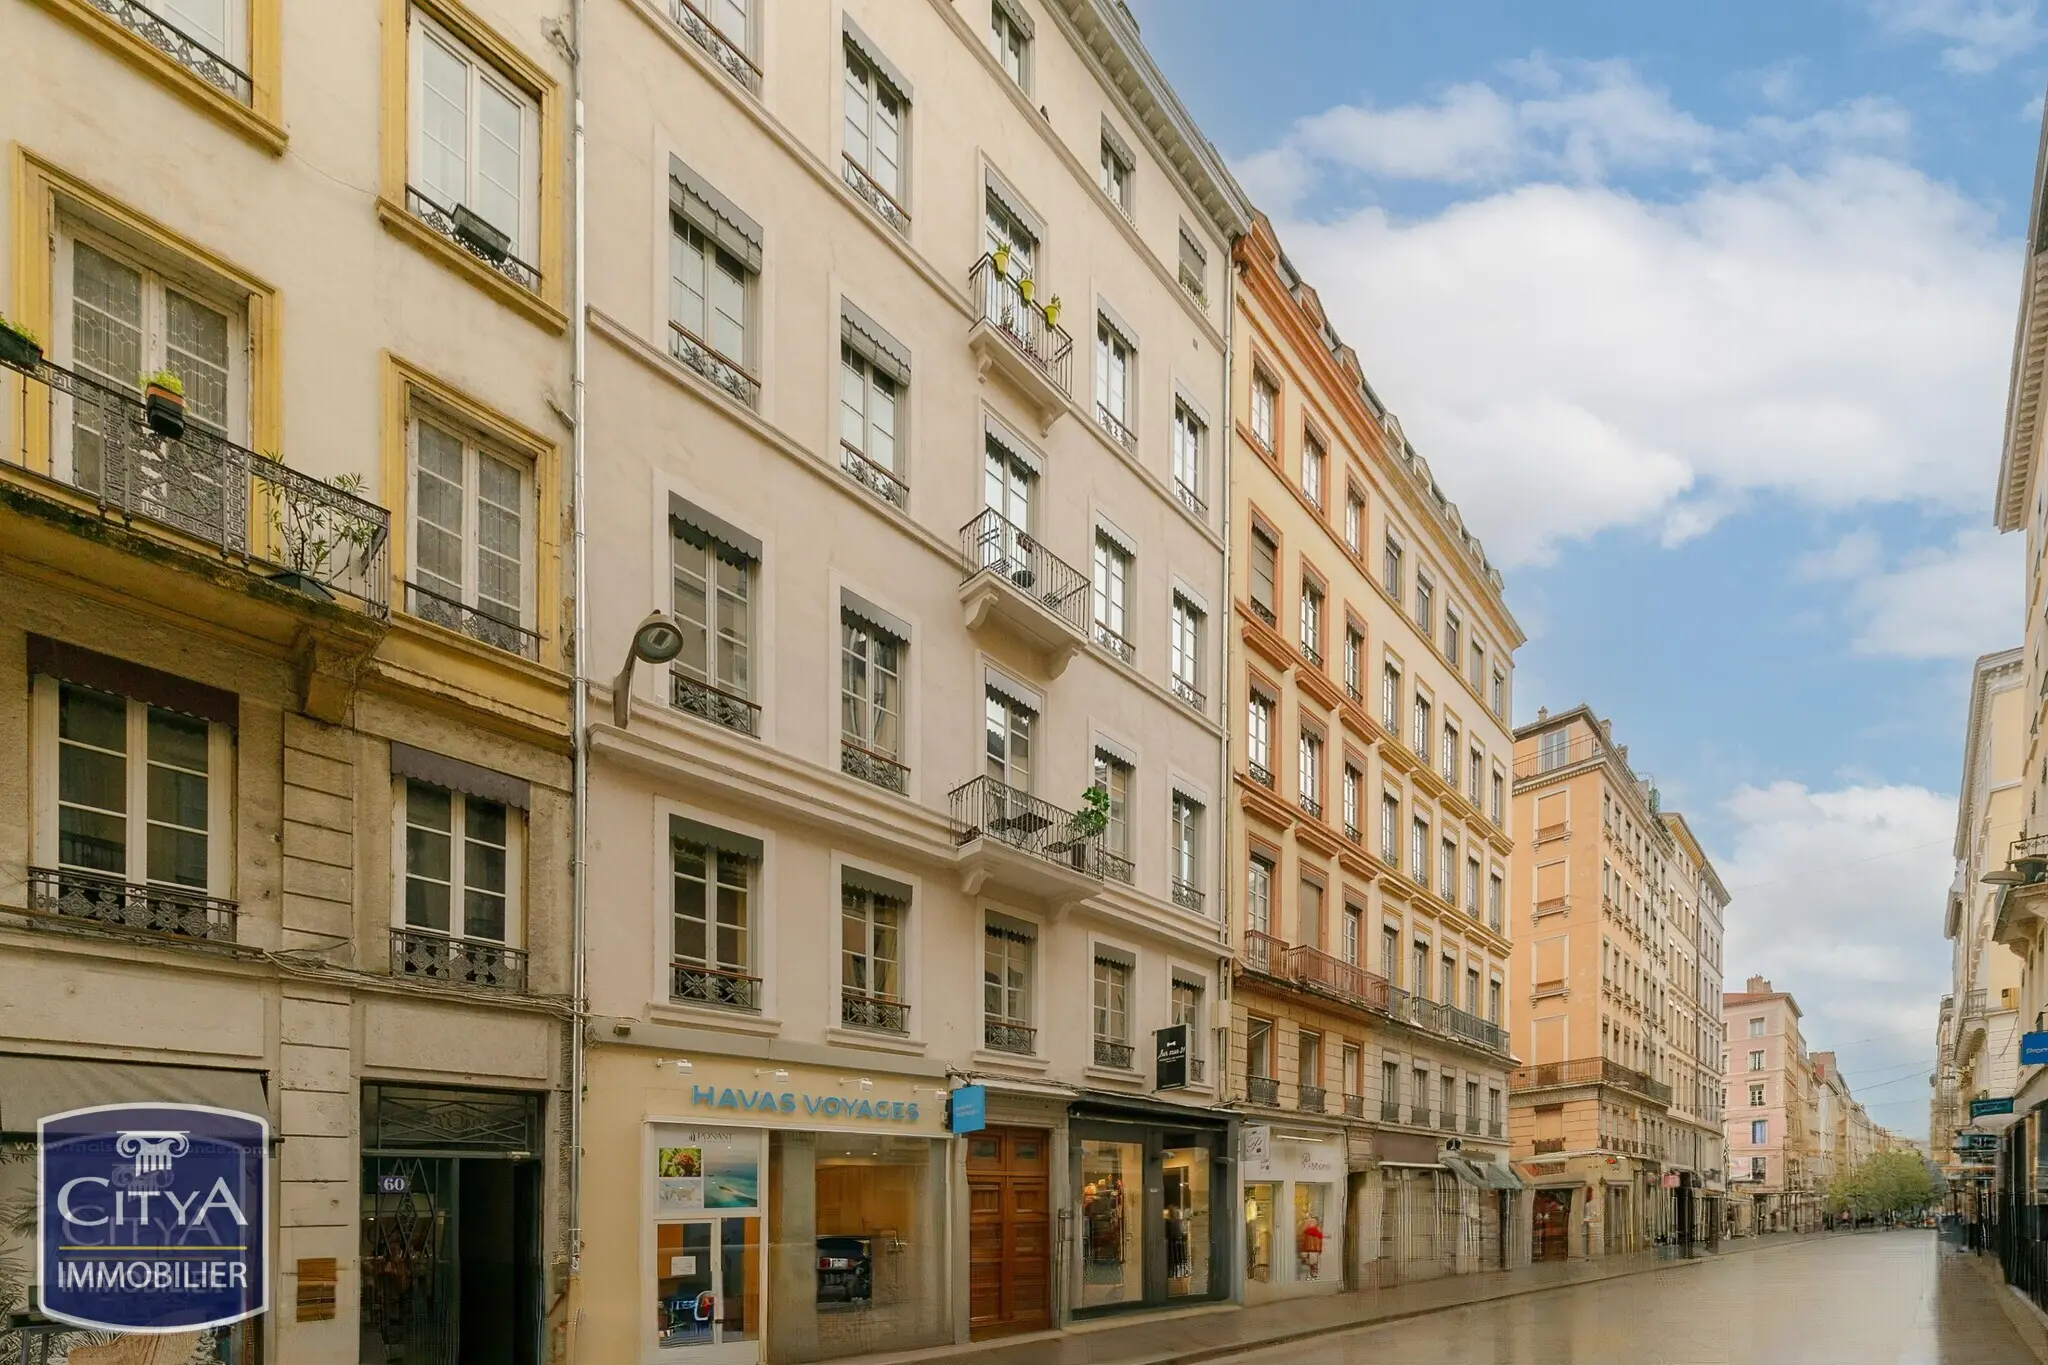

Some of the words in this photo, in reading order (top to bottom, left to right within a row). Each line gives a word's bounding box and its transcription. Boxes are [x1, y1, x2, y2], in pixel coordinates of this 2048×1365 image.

[692, 1085, 797, 1113] HAVAS
[803, 1094, 920, 1121] VOYAGES
[383, 1177, 405, 1191] 60
